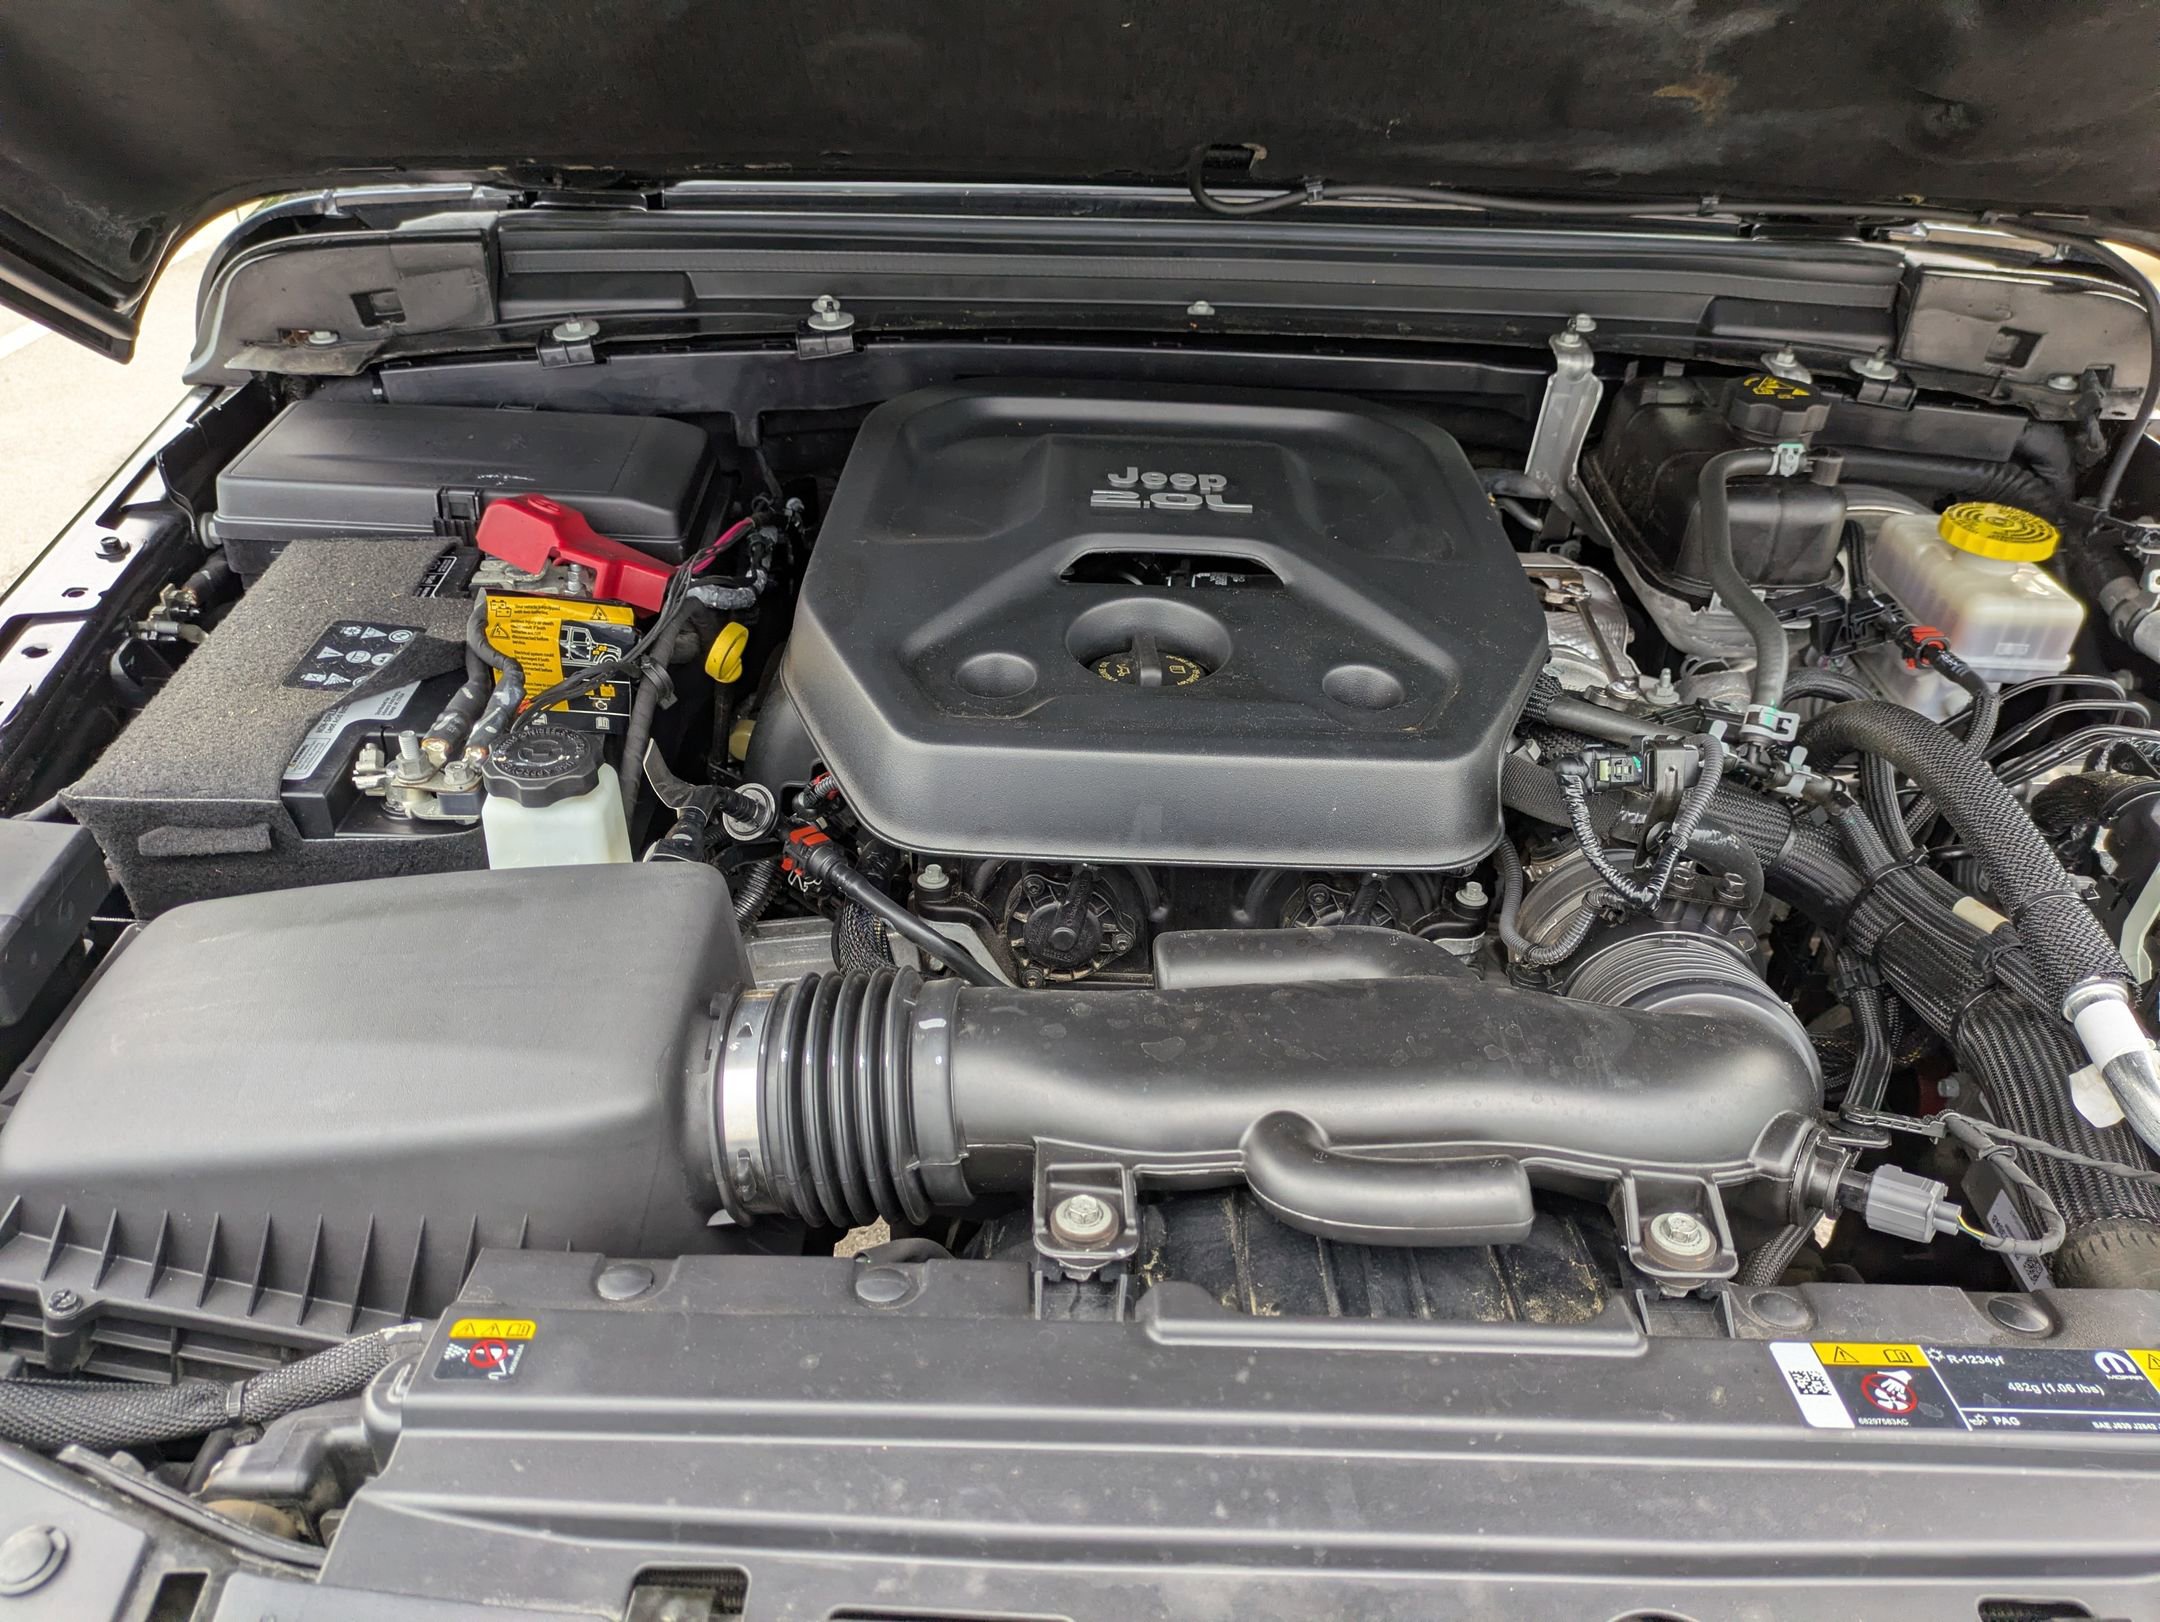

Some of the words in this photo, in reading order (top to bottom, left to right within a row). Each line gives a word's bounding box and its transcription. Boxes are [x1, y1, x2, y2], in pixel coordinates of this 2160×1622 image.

[1108, 466, 1228, 494] Jeep
[1090, 489, 1253, 513] 2.0L
[1946, 1354, 2005, 1367] R-1234yf
[2008, 1382, 2041, 1395] 482g
[2075, 1383, 2105, 1397] lbs)
[1992, 1416, 2021, 1426] PAG
